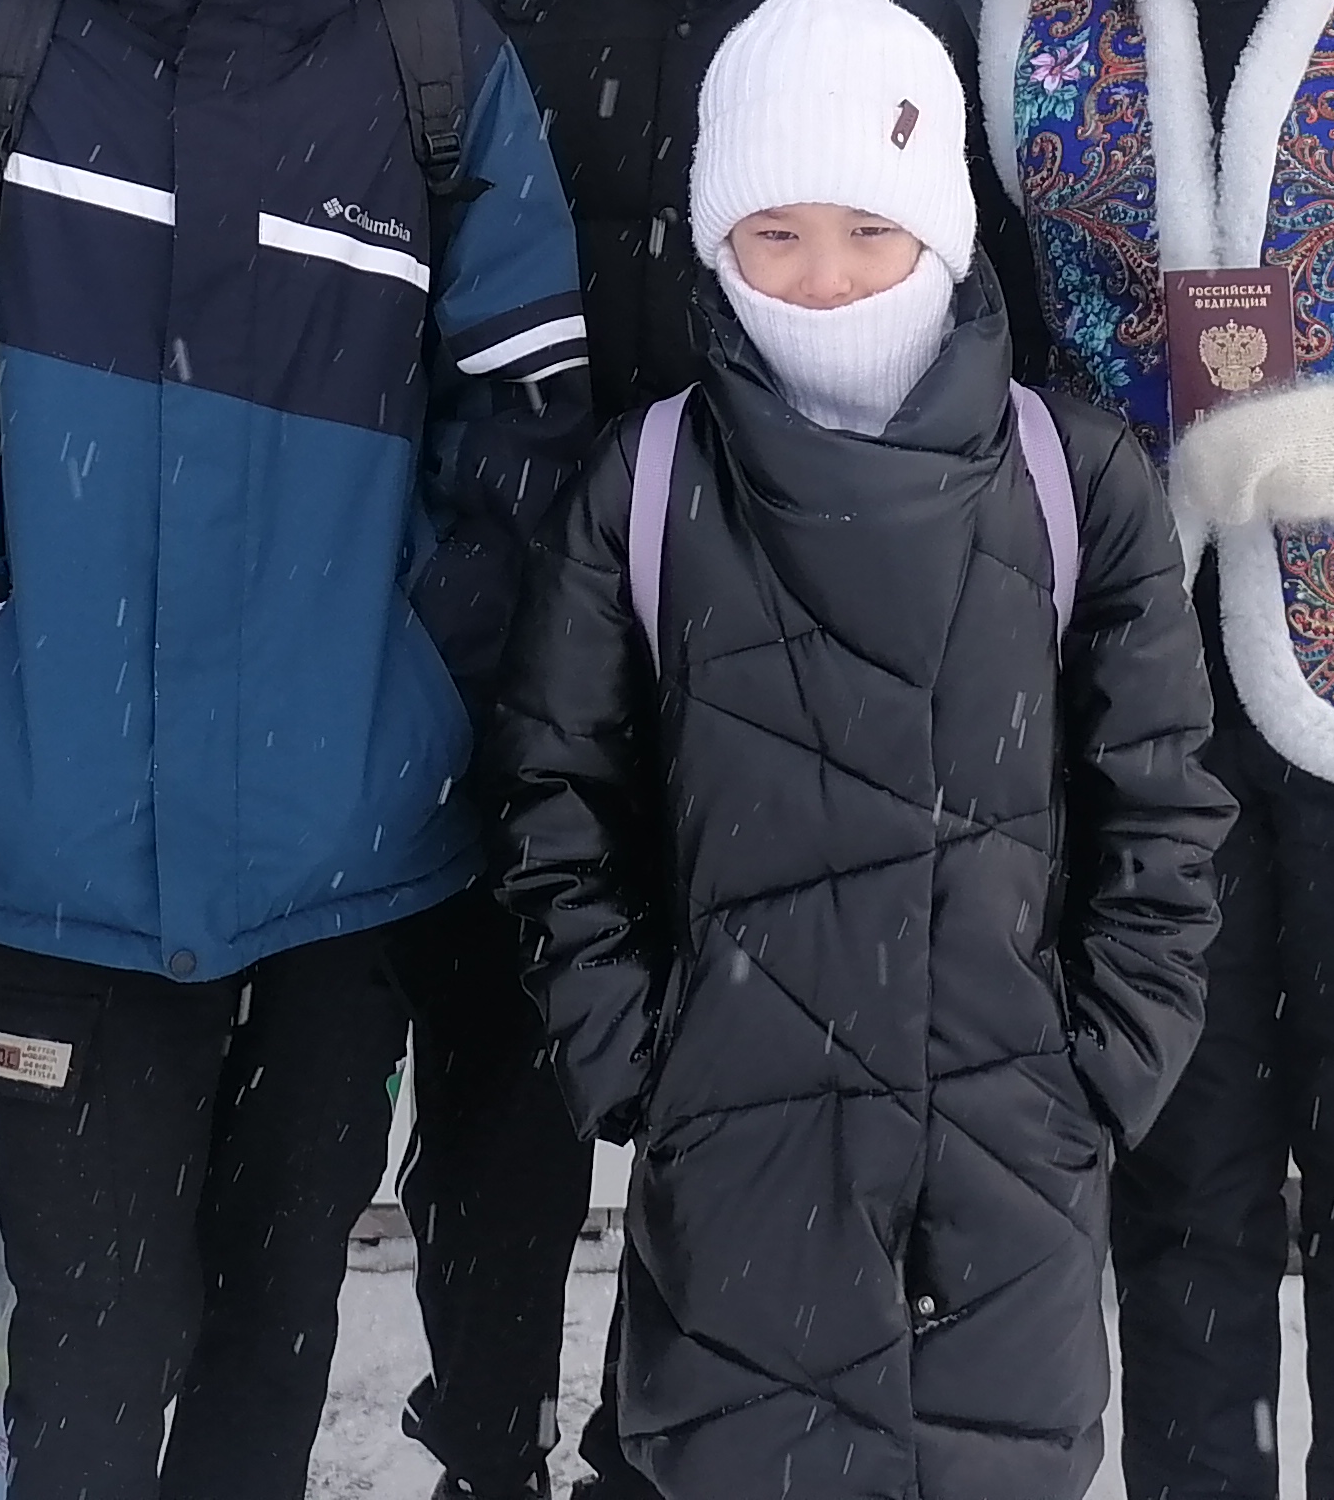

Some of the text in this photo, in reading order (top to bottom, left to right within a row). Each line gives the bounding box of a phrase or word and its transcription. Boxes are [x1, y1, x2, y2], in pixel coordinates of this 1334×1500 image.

[344, 204, 411, 242] Columbia
[1188, 285, 1272, 297] РОССИЙСКАЯ
[1195, 297, 1267, 309] ФЕДЕРАЦИЯ
